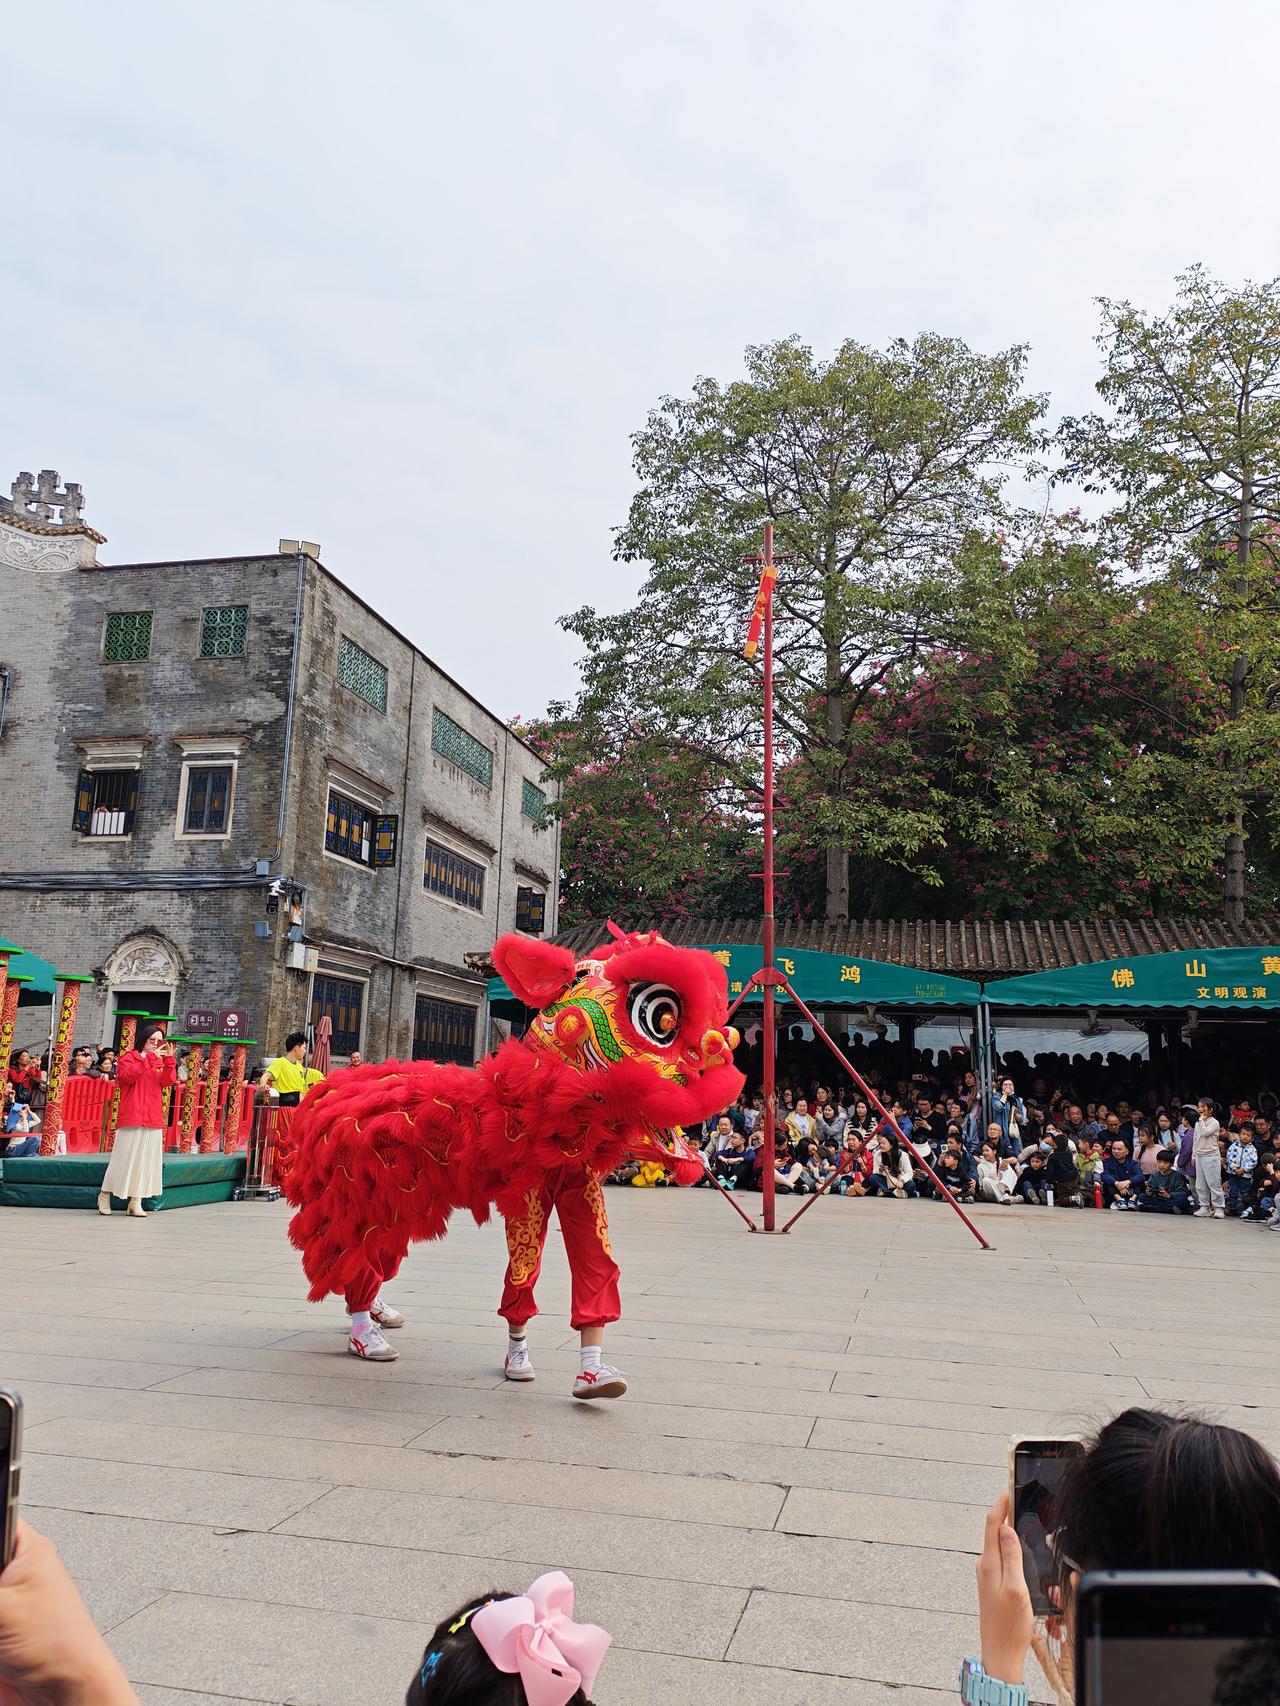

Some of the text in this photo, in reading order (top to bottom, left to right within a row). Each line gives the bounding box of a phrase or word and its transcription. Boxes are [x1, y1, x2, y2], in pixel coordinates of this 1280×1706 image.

[1197, 987, 1267, 999] 文明观演
[57, 998, 73, 1042] 身体健康
[48, 1055, 63, 1101] 工作顺利
